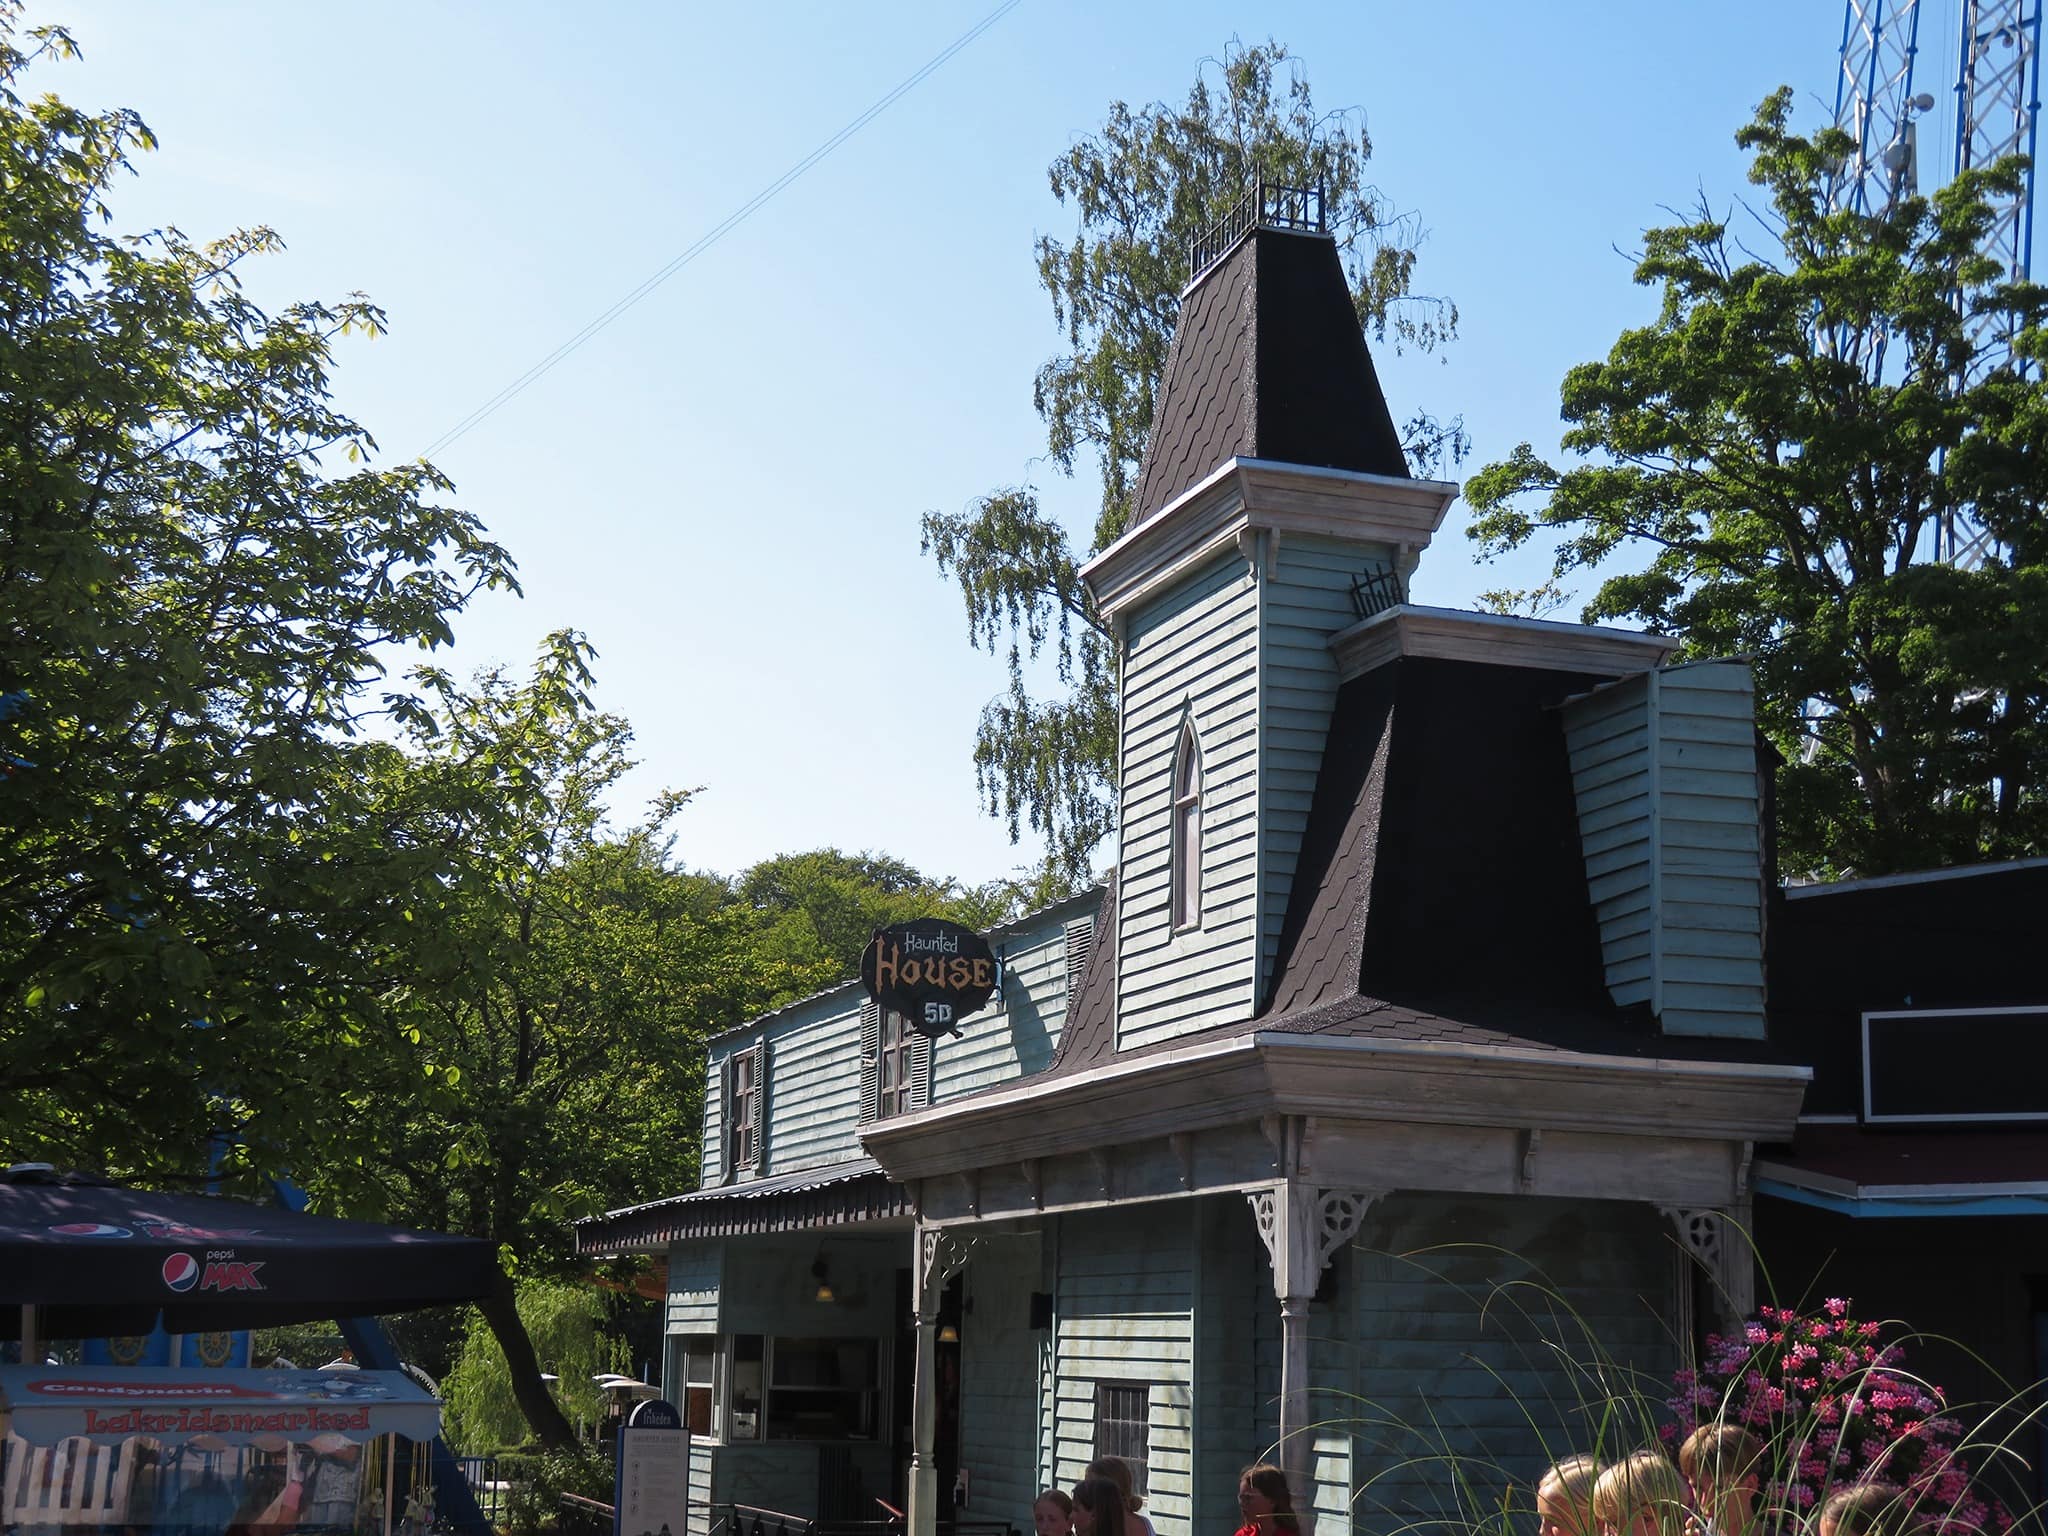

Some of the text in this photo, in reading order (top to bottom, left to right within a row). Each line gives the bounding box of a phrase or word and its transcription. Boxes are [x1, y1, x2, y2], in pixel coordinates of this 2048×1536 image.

[904, 929, 958, 954] Haunted
[924, 1002, 953, 1024] 5D
[206, 1249, 235, 1261] pepsi
[200, 1262, 267, 1292] MAX
[42, 1383, 233, 1396] Candynavia
[84, 1406, 371, 1434] Lakridsmarked
